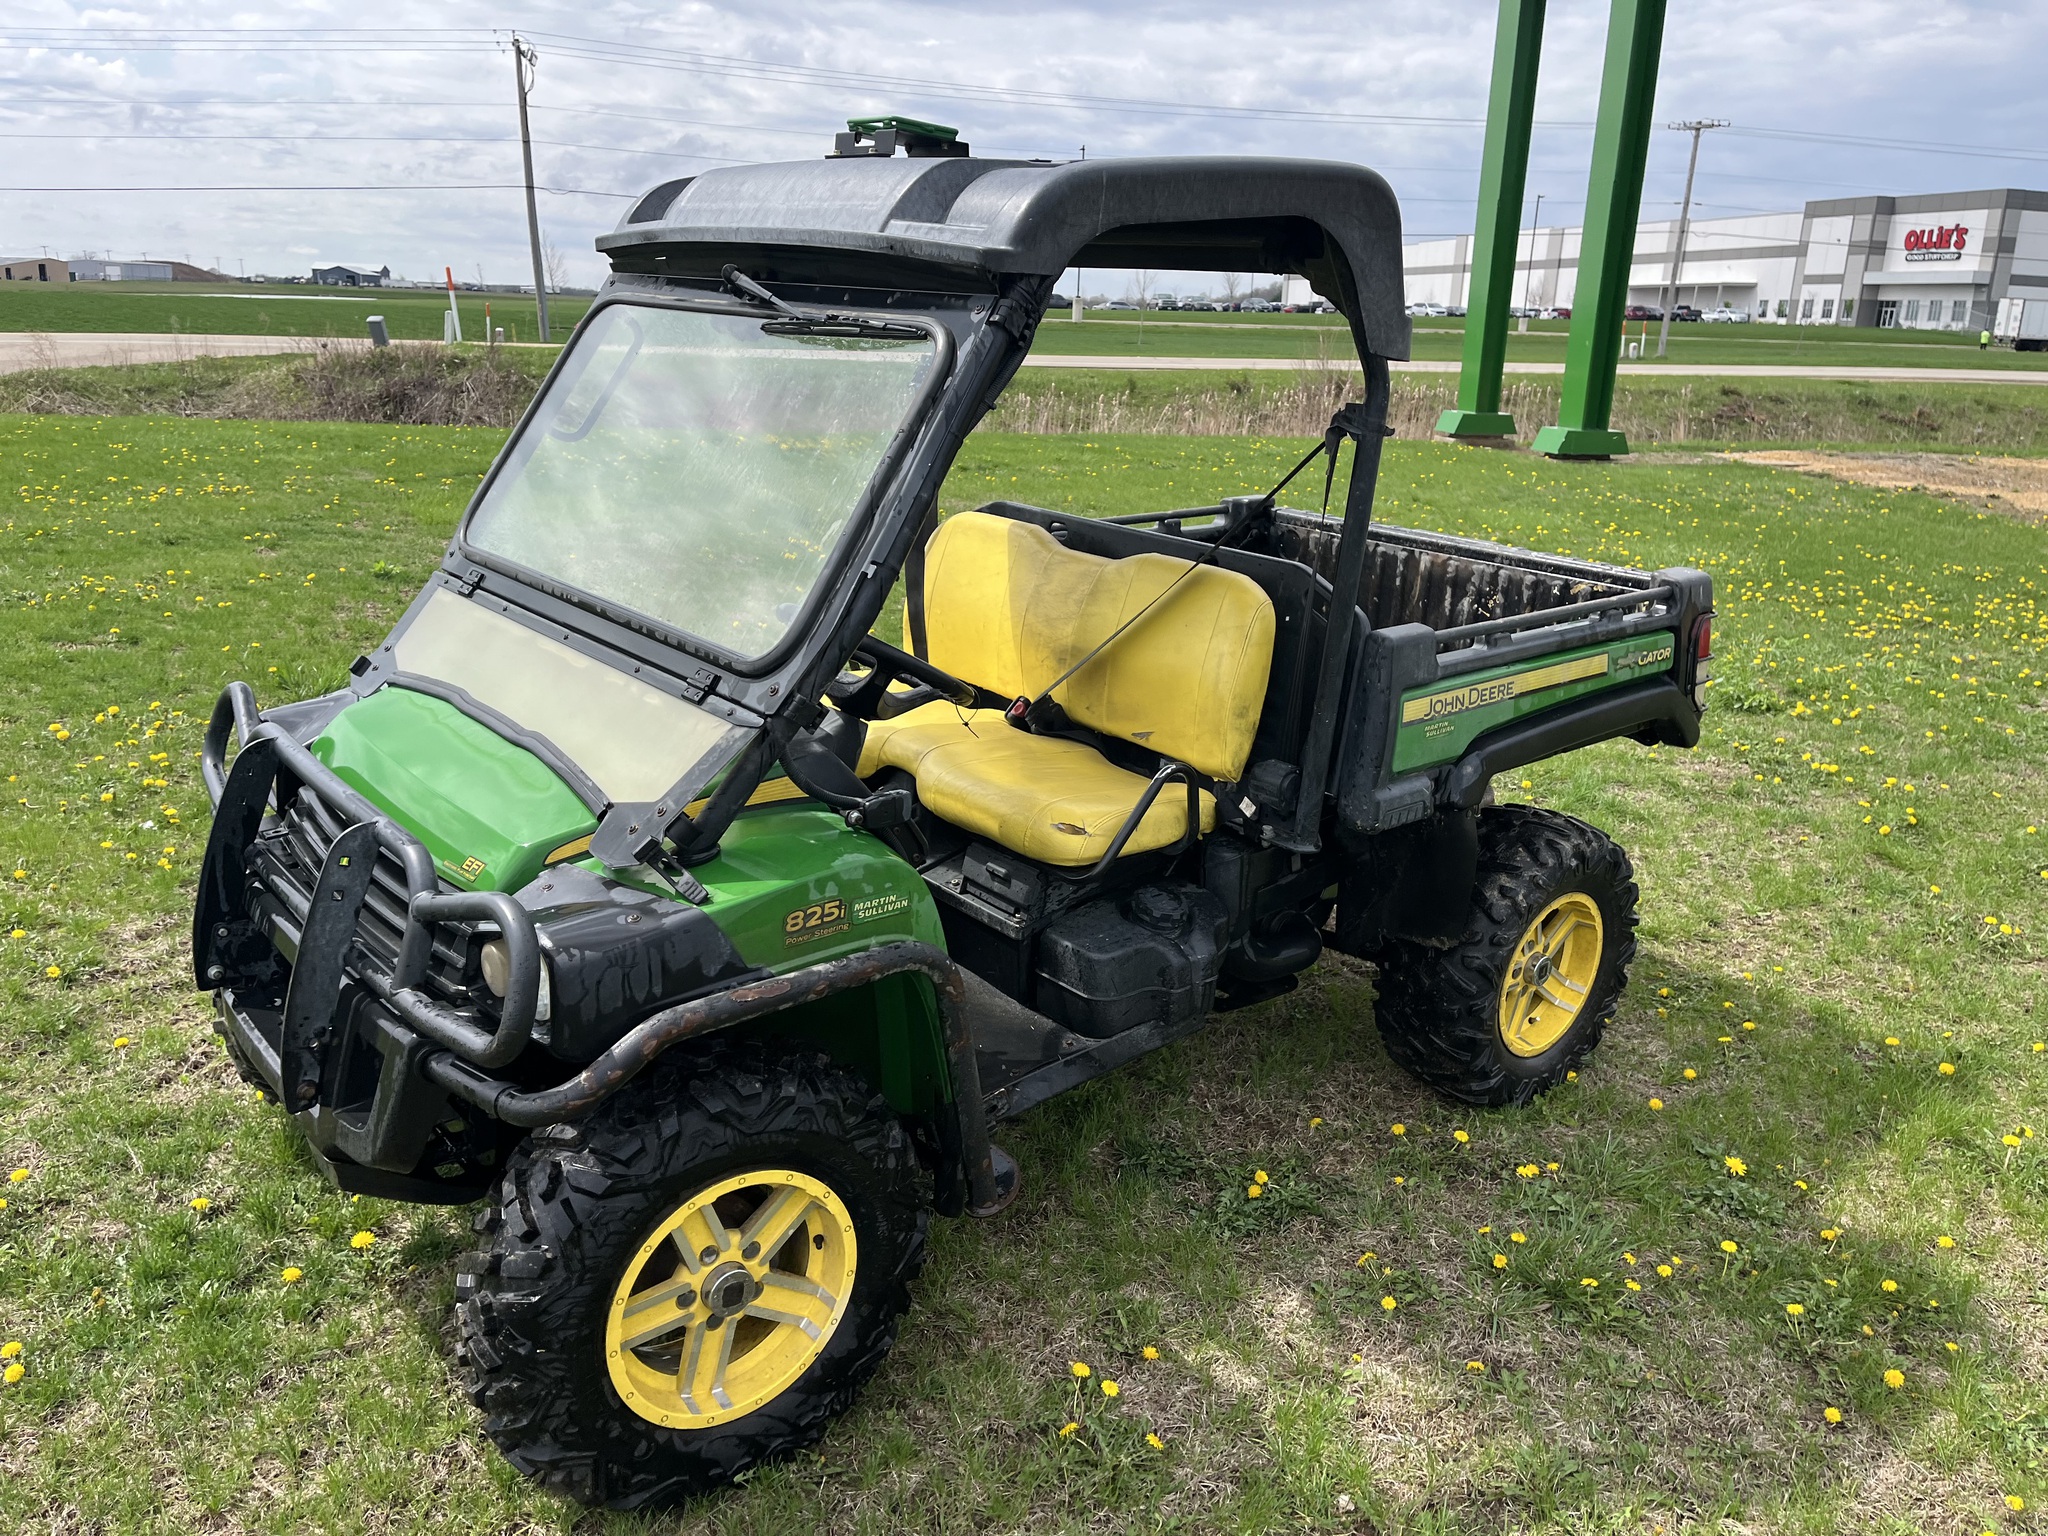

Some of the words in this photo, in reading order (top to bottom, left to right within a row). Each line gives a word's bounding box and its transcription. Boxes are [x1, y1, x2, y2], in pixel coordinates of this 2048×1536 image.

[1904, 223, 1969, 251] OLLIE'S
[1637, 647, 1672, 666] GATOR
[1423, 693, 1466, 719] JOHN
[1468, 681, 1515, 706] DEERE
[1424, 721, 1450, 732] MARTIN
[461, 856, 486, 876] EFI
[854, 894, 898, 911] MARTIN
[858, 899, 909, 919] SULLIVAN
[785, 900, 846, 932] 825i
[785, 933, 812, 946] Power
[814, 923, 850, 938] Steering
